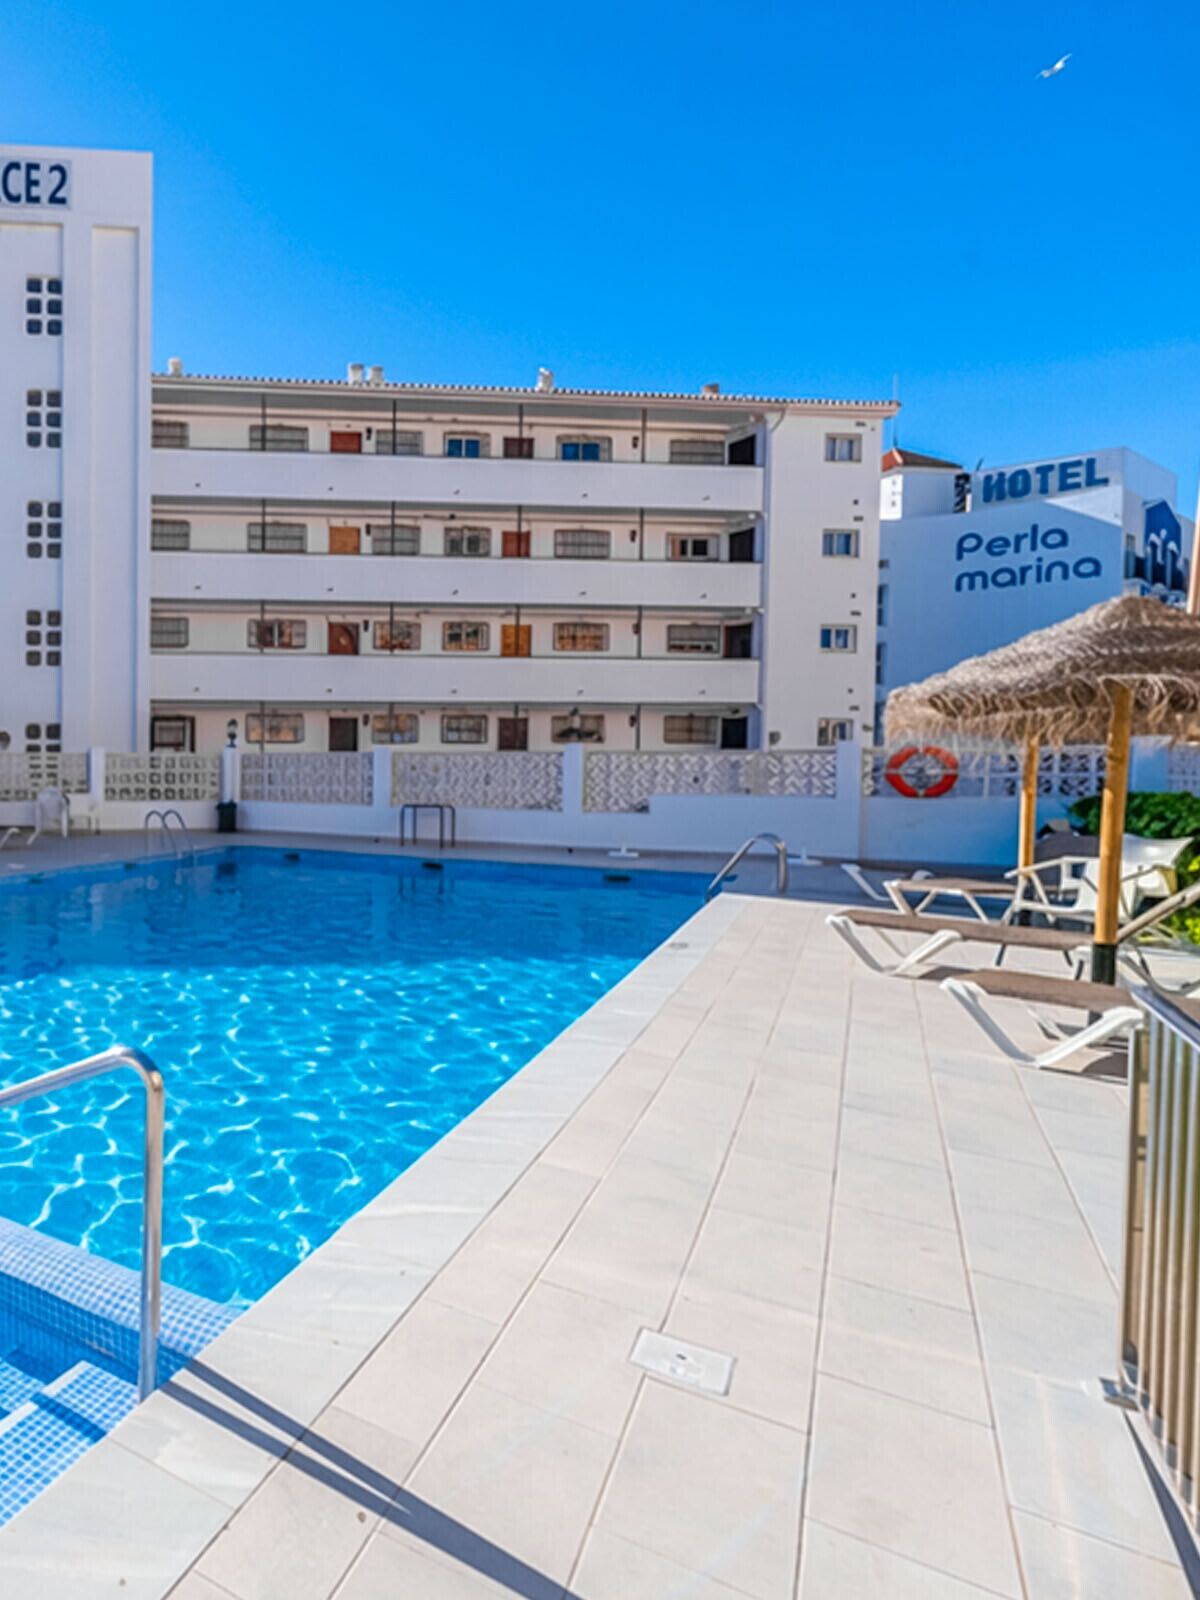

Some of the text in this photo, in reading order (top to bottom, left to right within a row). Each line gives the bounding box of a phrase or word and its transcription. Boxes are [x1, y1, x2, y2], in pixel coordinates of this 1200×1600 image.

[47, 163, 68, 205] 2
[982, 457, 1110, 503] HOTEL
[955, 556, 1102, 592] marina
